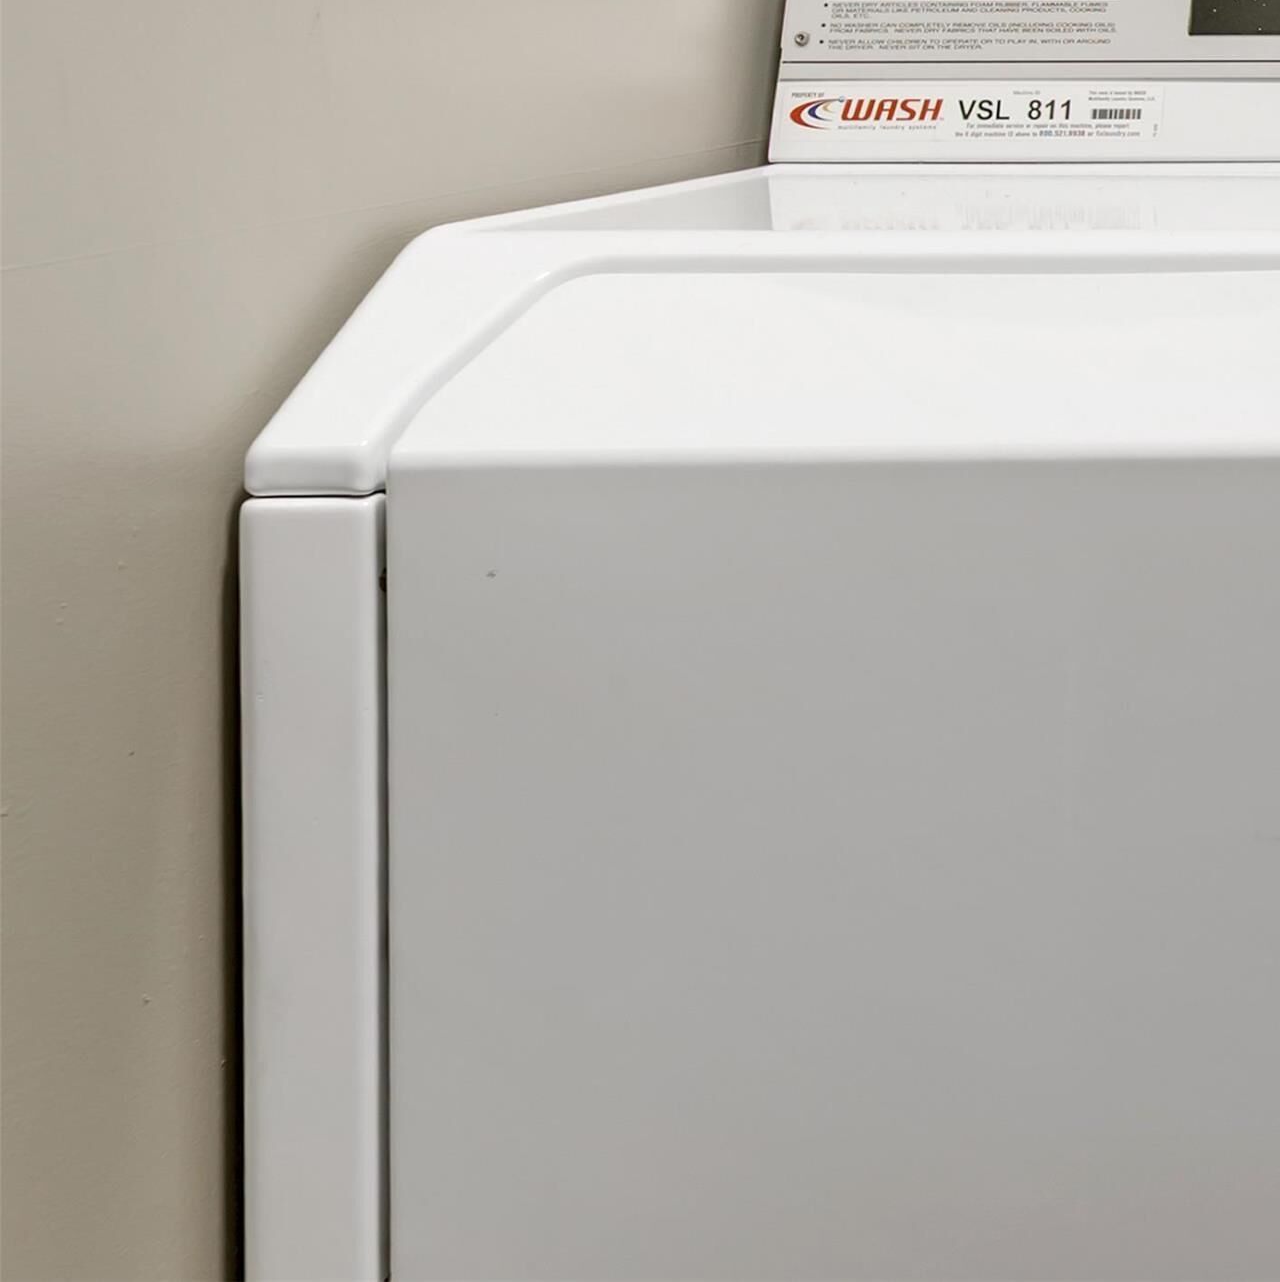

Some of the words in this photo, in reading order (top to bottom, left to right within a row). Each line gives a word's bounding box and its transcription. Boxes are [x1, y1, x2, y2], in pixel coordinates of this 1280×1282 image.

[841, 99, 944, 121] WASH
[958, 99, 1010, 120] VSL
[1027, 99, 1072, 120] 811
